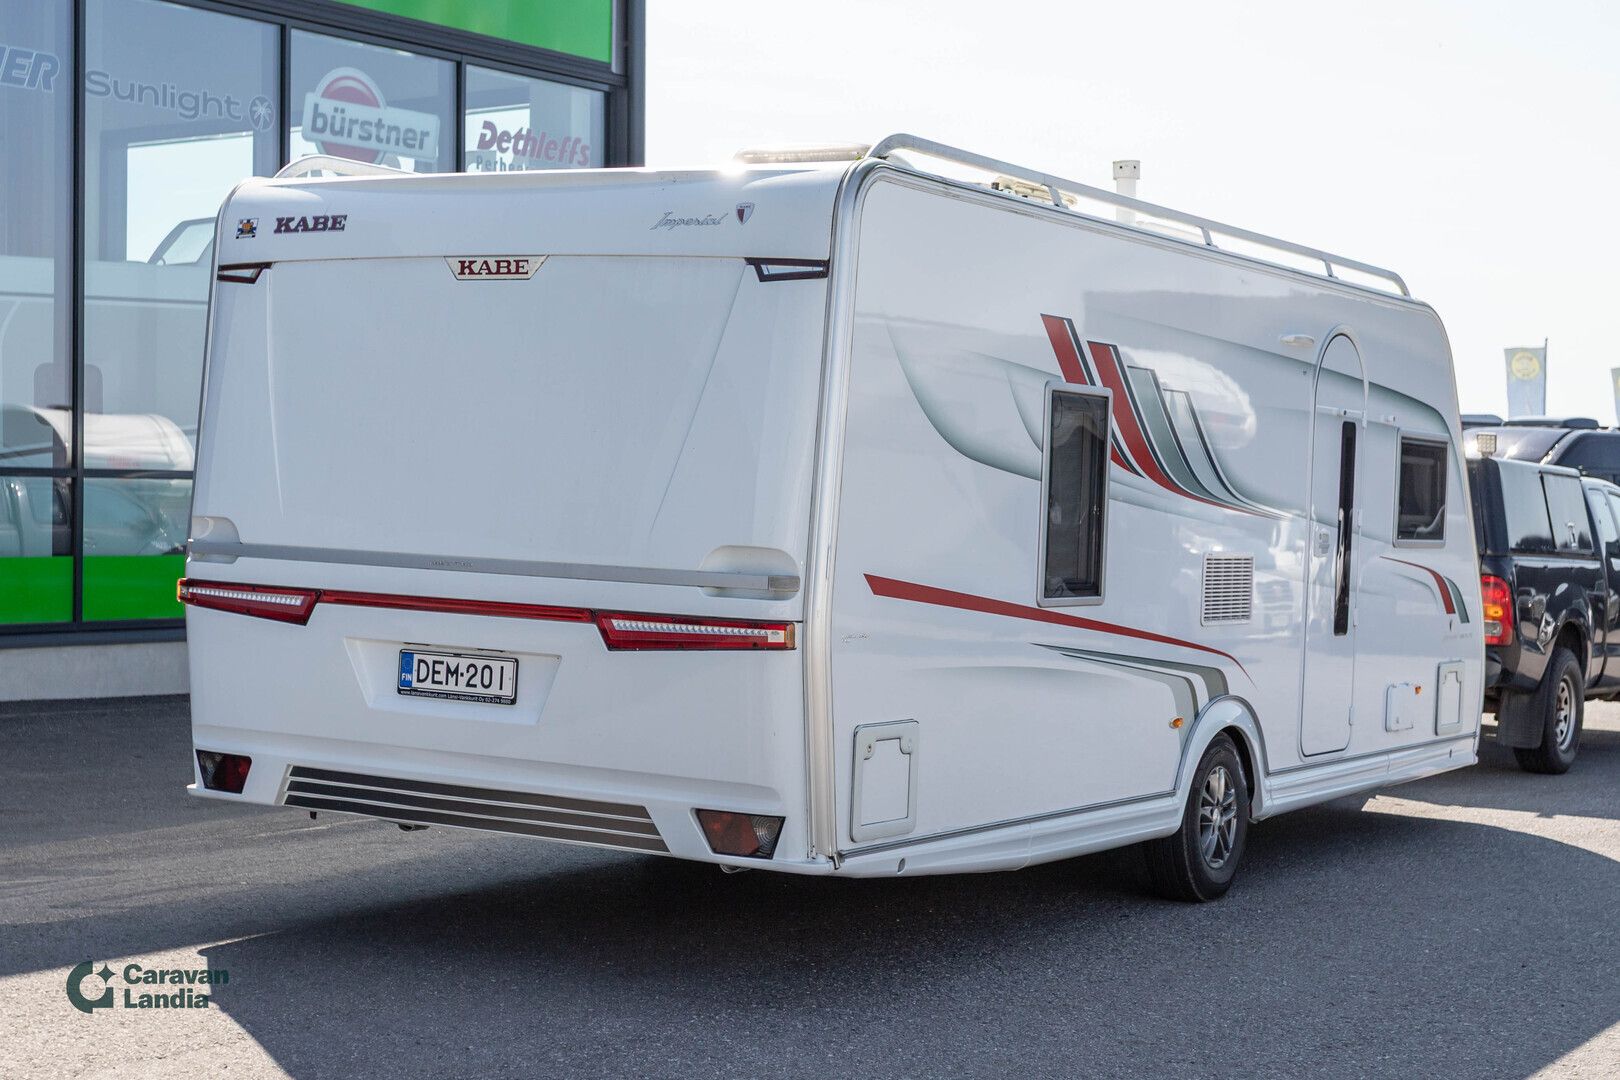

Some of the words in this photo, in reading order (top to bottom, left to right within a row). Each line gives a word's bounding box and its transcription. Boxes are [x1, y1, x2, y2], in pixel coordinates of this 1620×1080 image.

[85, 70, 242, 120] Sunlight
[310, 103, 430, 151] bürstner
[477, 120, 591, 167] Dethleffs
[273, 214, 348, 234] KABE
[649, 210, 729, 231] Imperial
[457, 259, 529, 276] KABE
[402, 673, 412, 681] FIN
[416, 659, 505, 691] DEM-201
